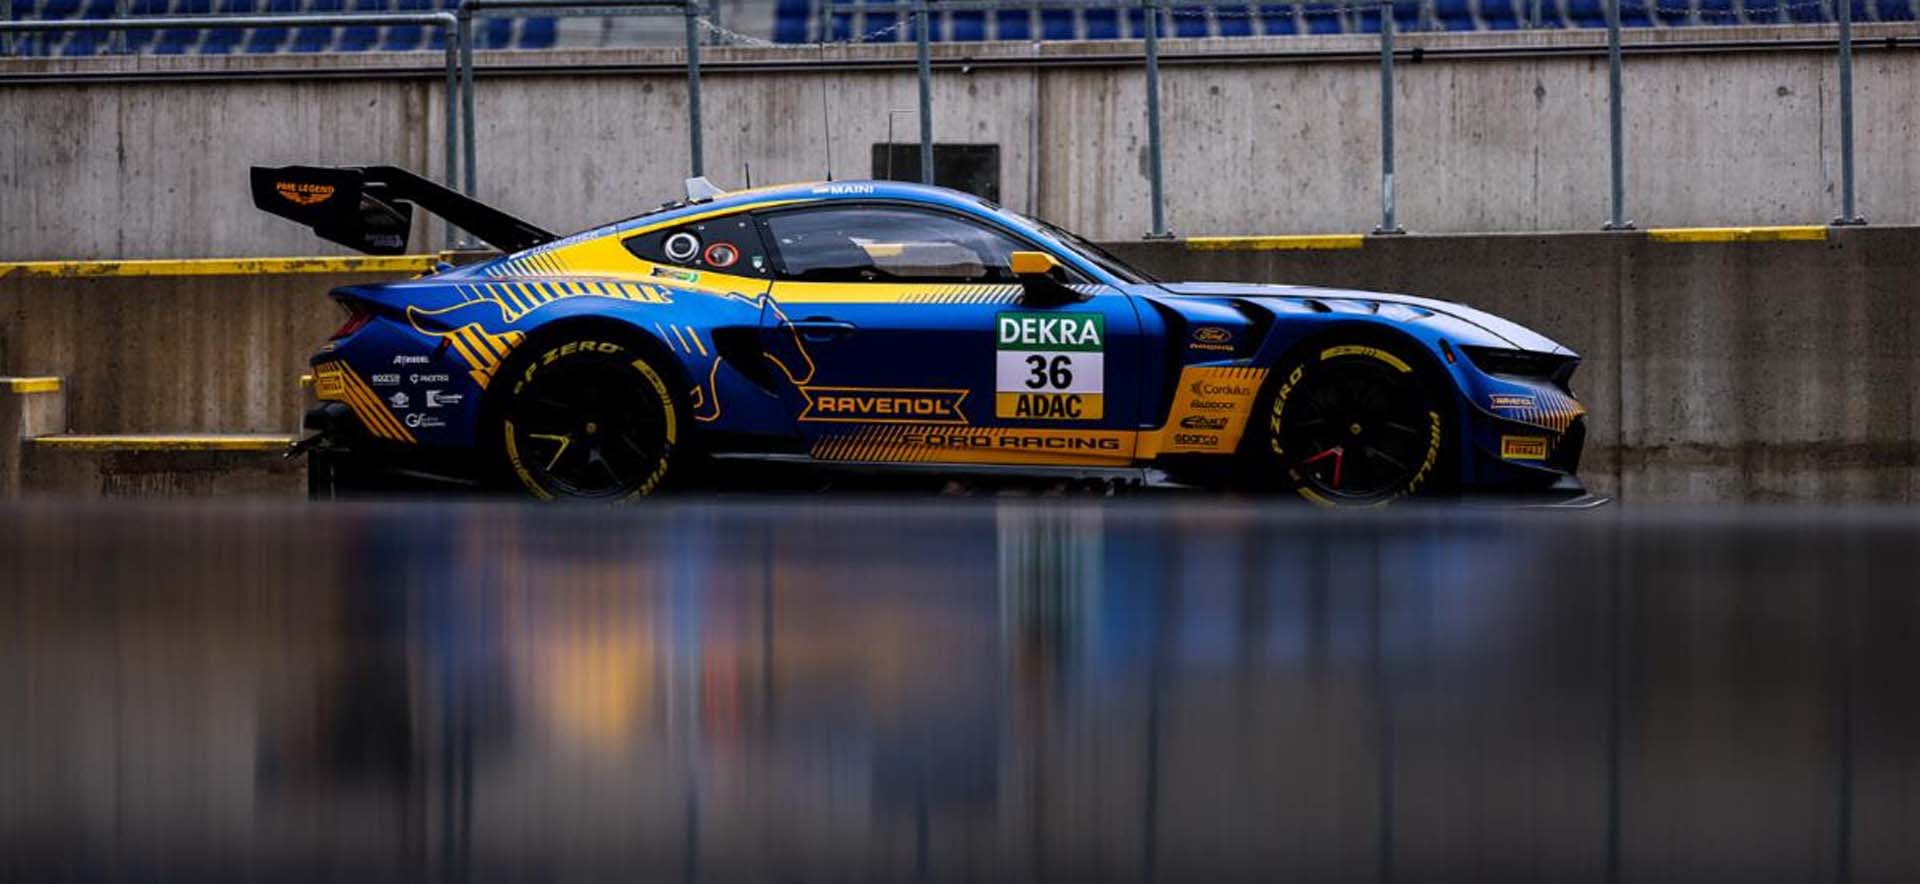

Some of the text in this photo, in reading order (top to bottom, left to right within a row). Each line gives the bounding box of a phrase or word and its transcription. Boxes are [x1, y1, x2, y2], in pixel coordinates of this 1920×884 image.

[298, 183, 336, 194] LEGEND
[831, 184, 873, 194] MAINI
[1000, 317, 1101, 345] DEKRA
[542, 340, 618, 366] ZERO
[1025, 354, 1072, 390] 36
[818, 397, 950, 415] RAVENOL
[1016, 394, 1082, 417] ADAC
[1269, 366, 1304, 434] ZERO
[902, 434, 1120, 450] FORD RACING
